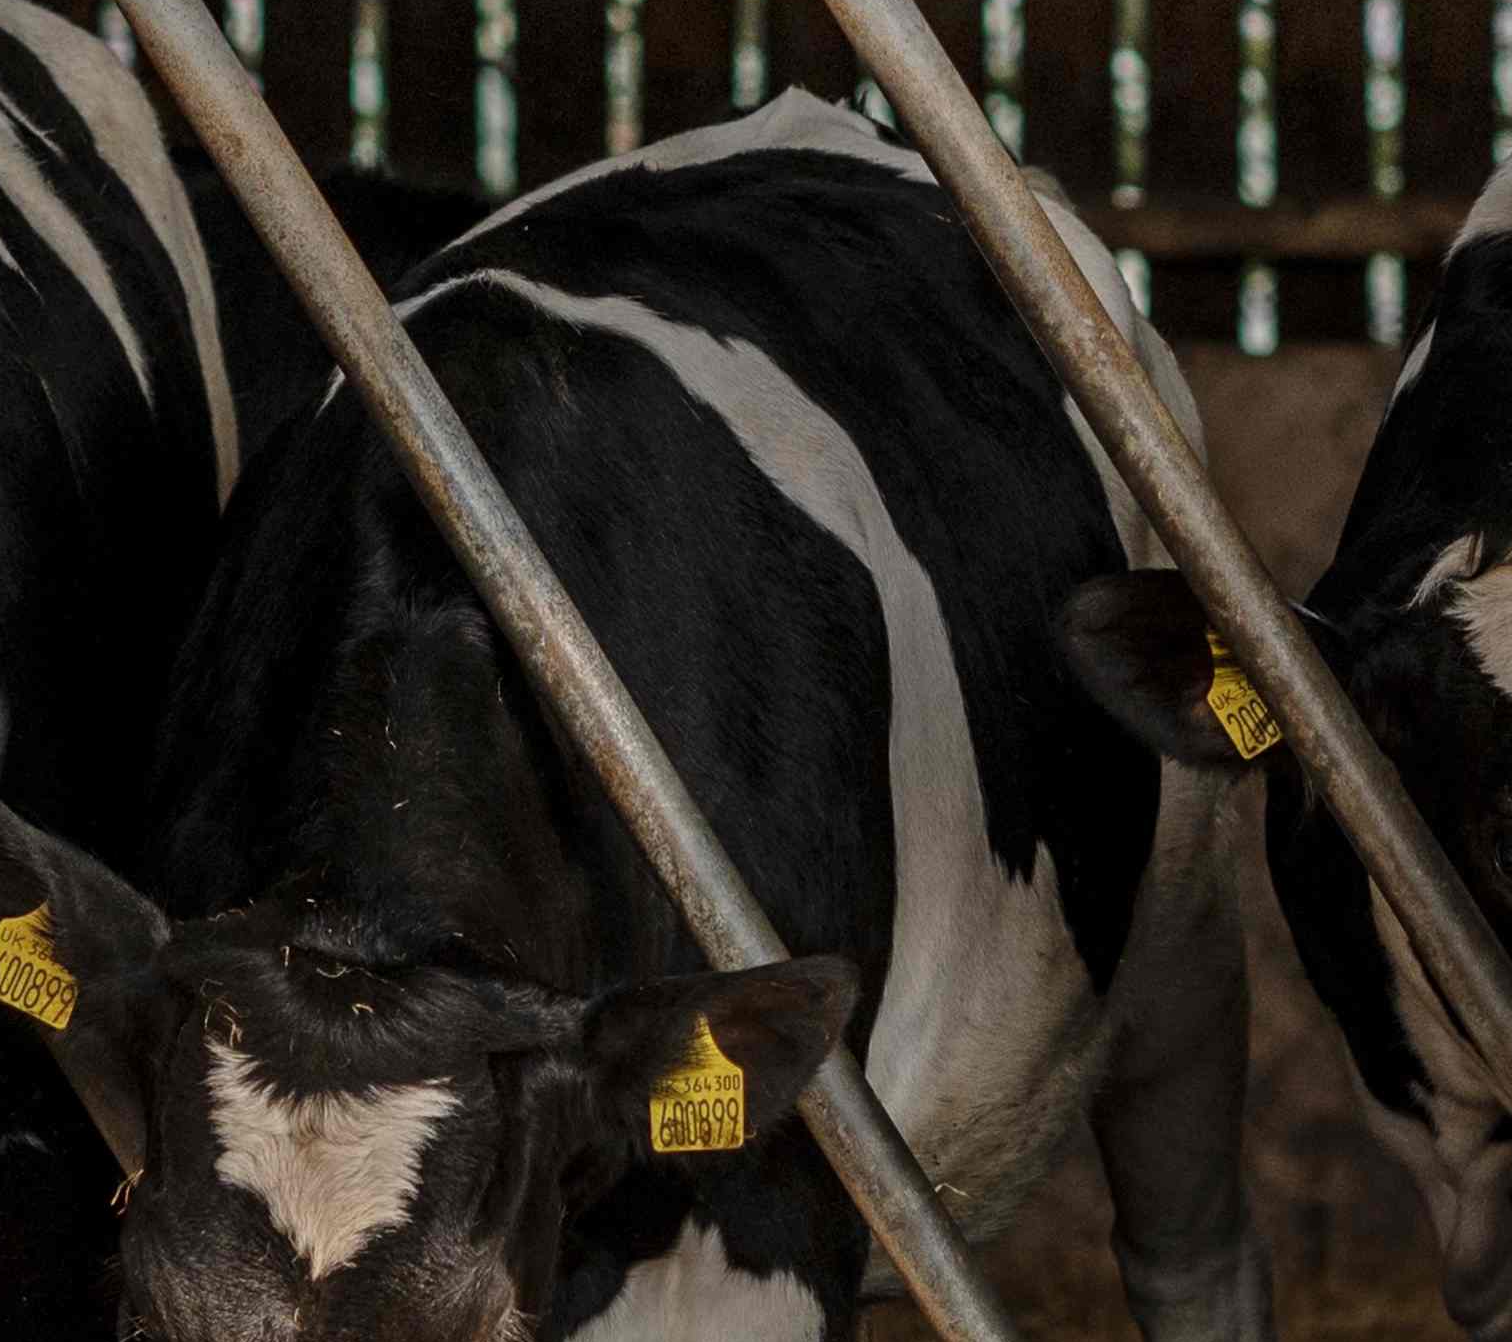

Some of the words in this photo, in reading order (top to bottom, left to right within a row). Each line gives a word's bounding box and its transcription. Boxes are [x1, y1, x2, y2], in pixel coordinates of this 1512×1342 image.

[0, 926, 25, 950] UK
[683, 1075, 740, 1093] 364300
[660, 1097, 739, 1147] 600899
